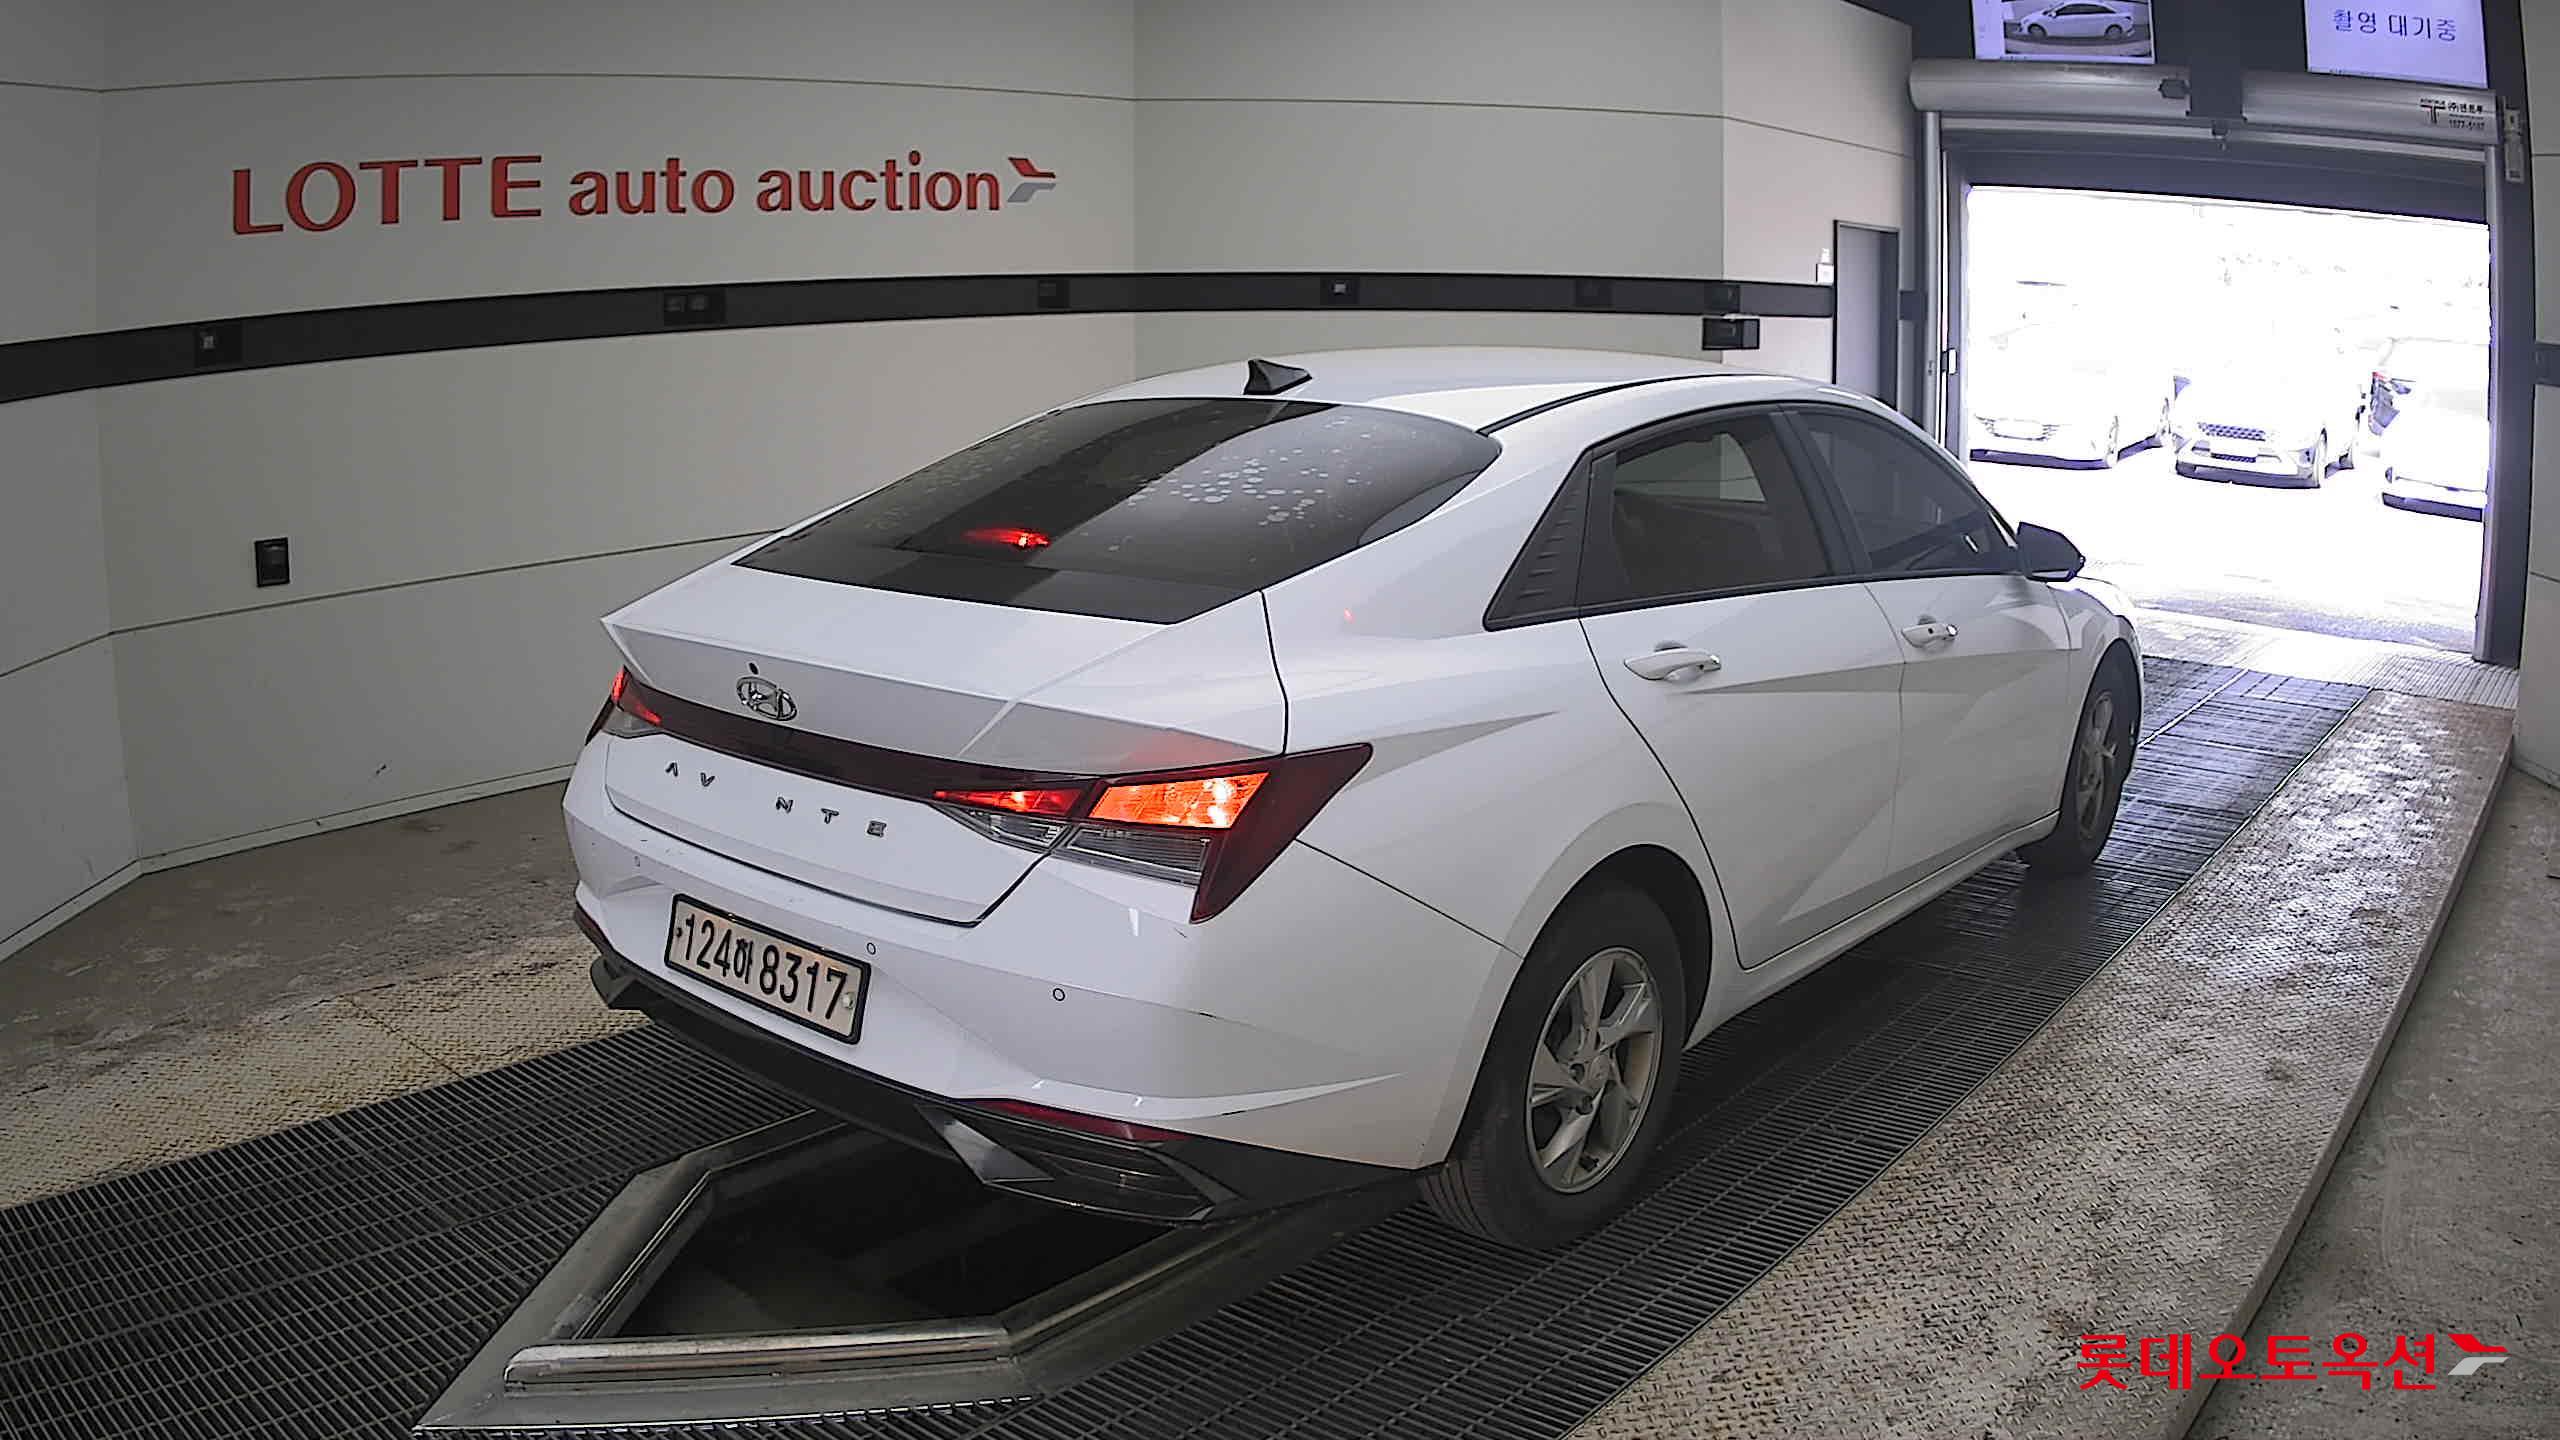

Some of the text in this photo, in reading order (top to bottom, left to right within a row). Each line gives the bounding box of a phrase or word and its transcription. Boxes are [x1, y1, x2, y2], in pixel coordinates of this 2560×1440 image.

[2388, 14, 2457, 42] 대기중
[233, 150, 1001, 234] LOTTE auto auction
[666, 762, 887, 837] AVNTE
[759, 944, 848, 1020] 8317
